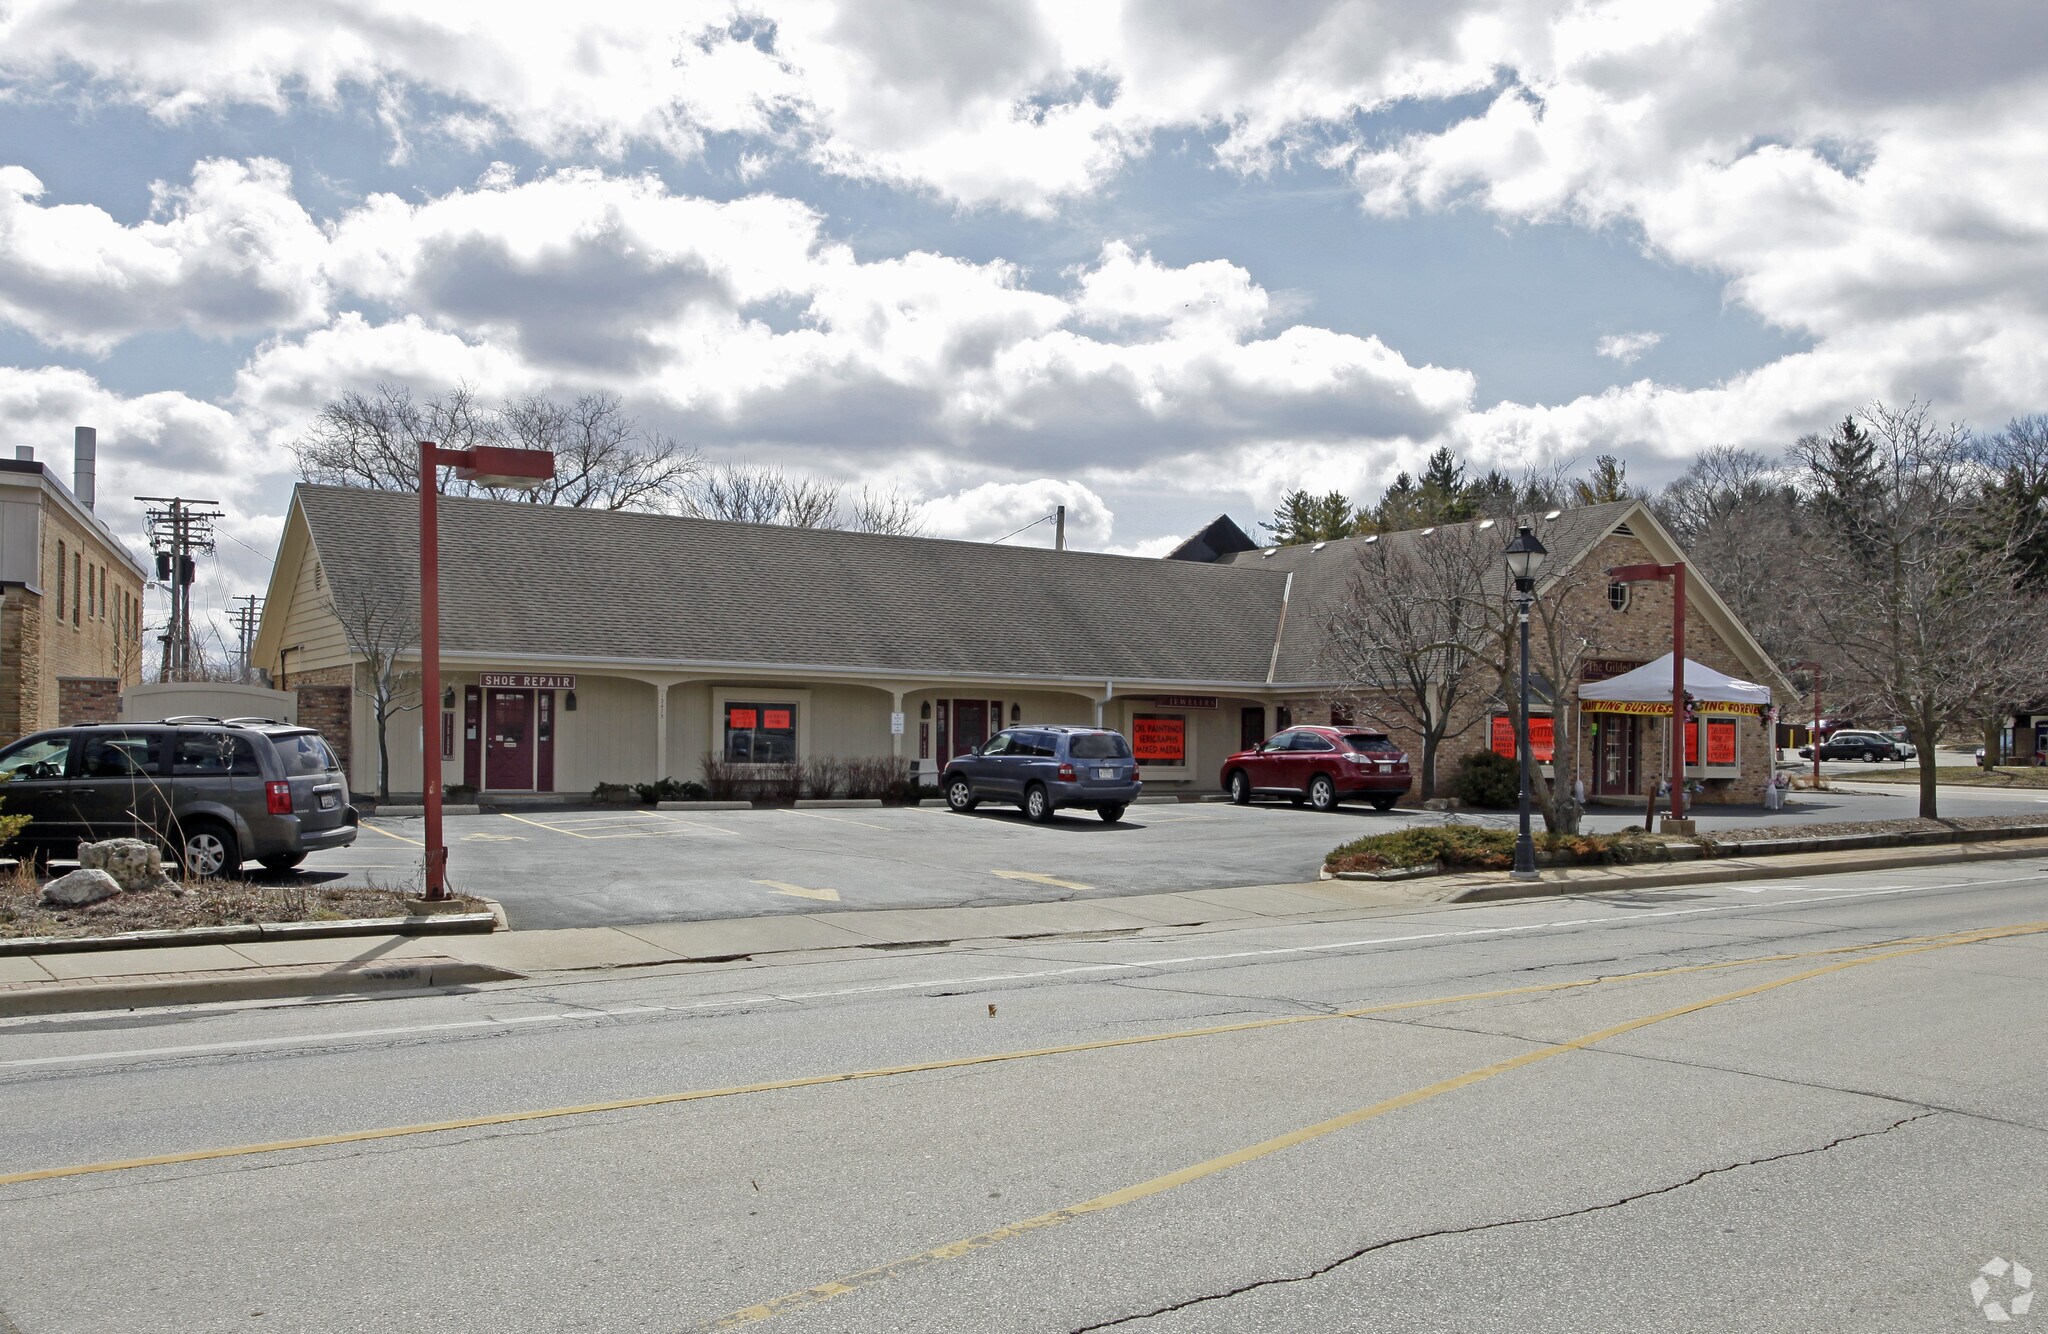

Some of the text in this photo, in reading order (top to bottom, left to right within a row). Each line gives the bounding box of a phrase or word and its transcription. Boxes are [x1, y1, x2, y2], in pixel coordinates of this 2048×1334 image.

[1588, 660, 1602, 672] The
[1605, 661, 1631, 673] Gilded
[485, 675, 570, 687] SHOE REPAIR
[1135, 724, 1183, 734] OIL PAINTINGS
[1136, 745, 1181, 754] MIXED MEDIA
